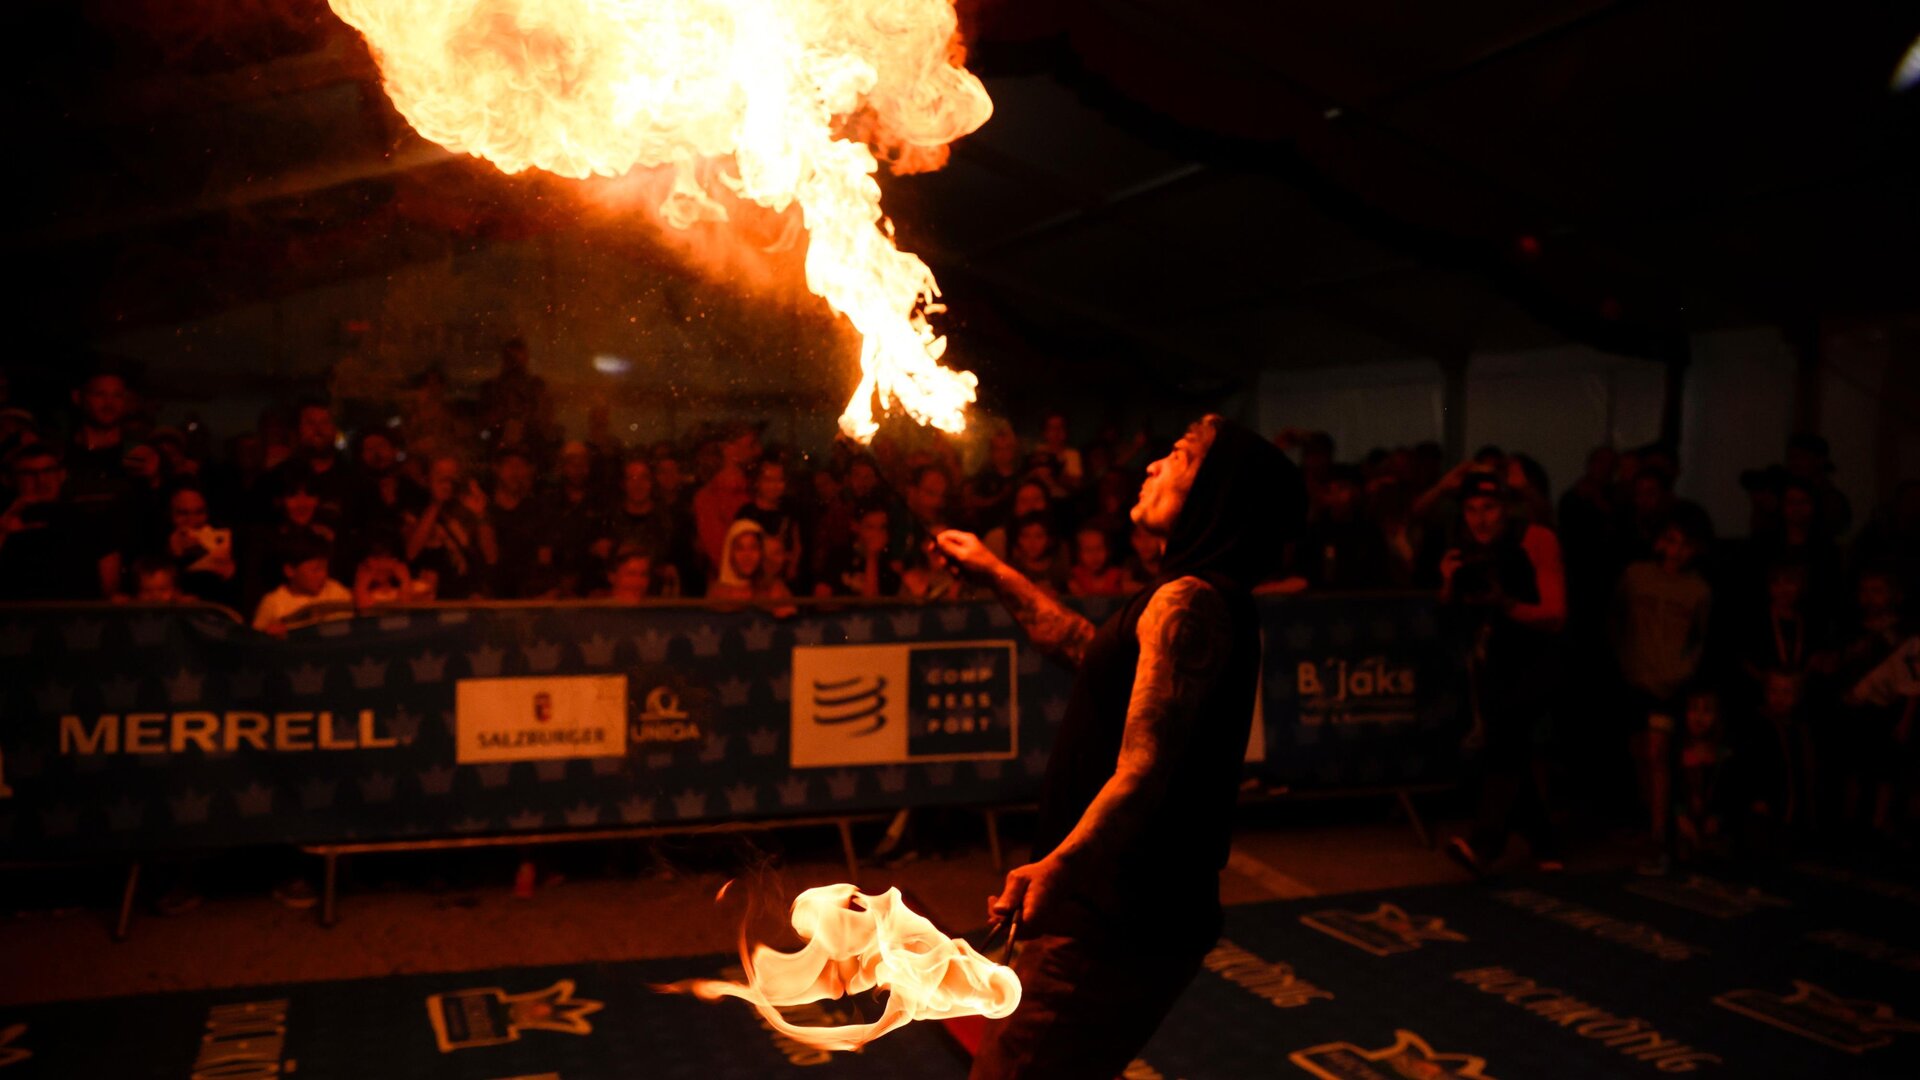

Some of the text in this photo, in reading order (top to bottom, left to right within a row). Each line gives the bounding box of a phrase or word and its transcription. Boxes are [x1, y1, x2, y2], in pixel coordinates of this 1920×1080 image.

[926, 665, 993, 686] COMP
[926, 692, 992, 710] RESS
[58, 708, 399, 755] MERRELL
[926, 716, 991, 735] PORT
[477, 728, 606, 750] SALZBURGER
